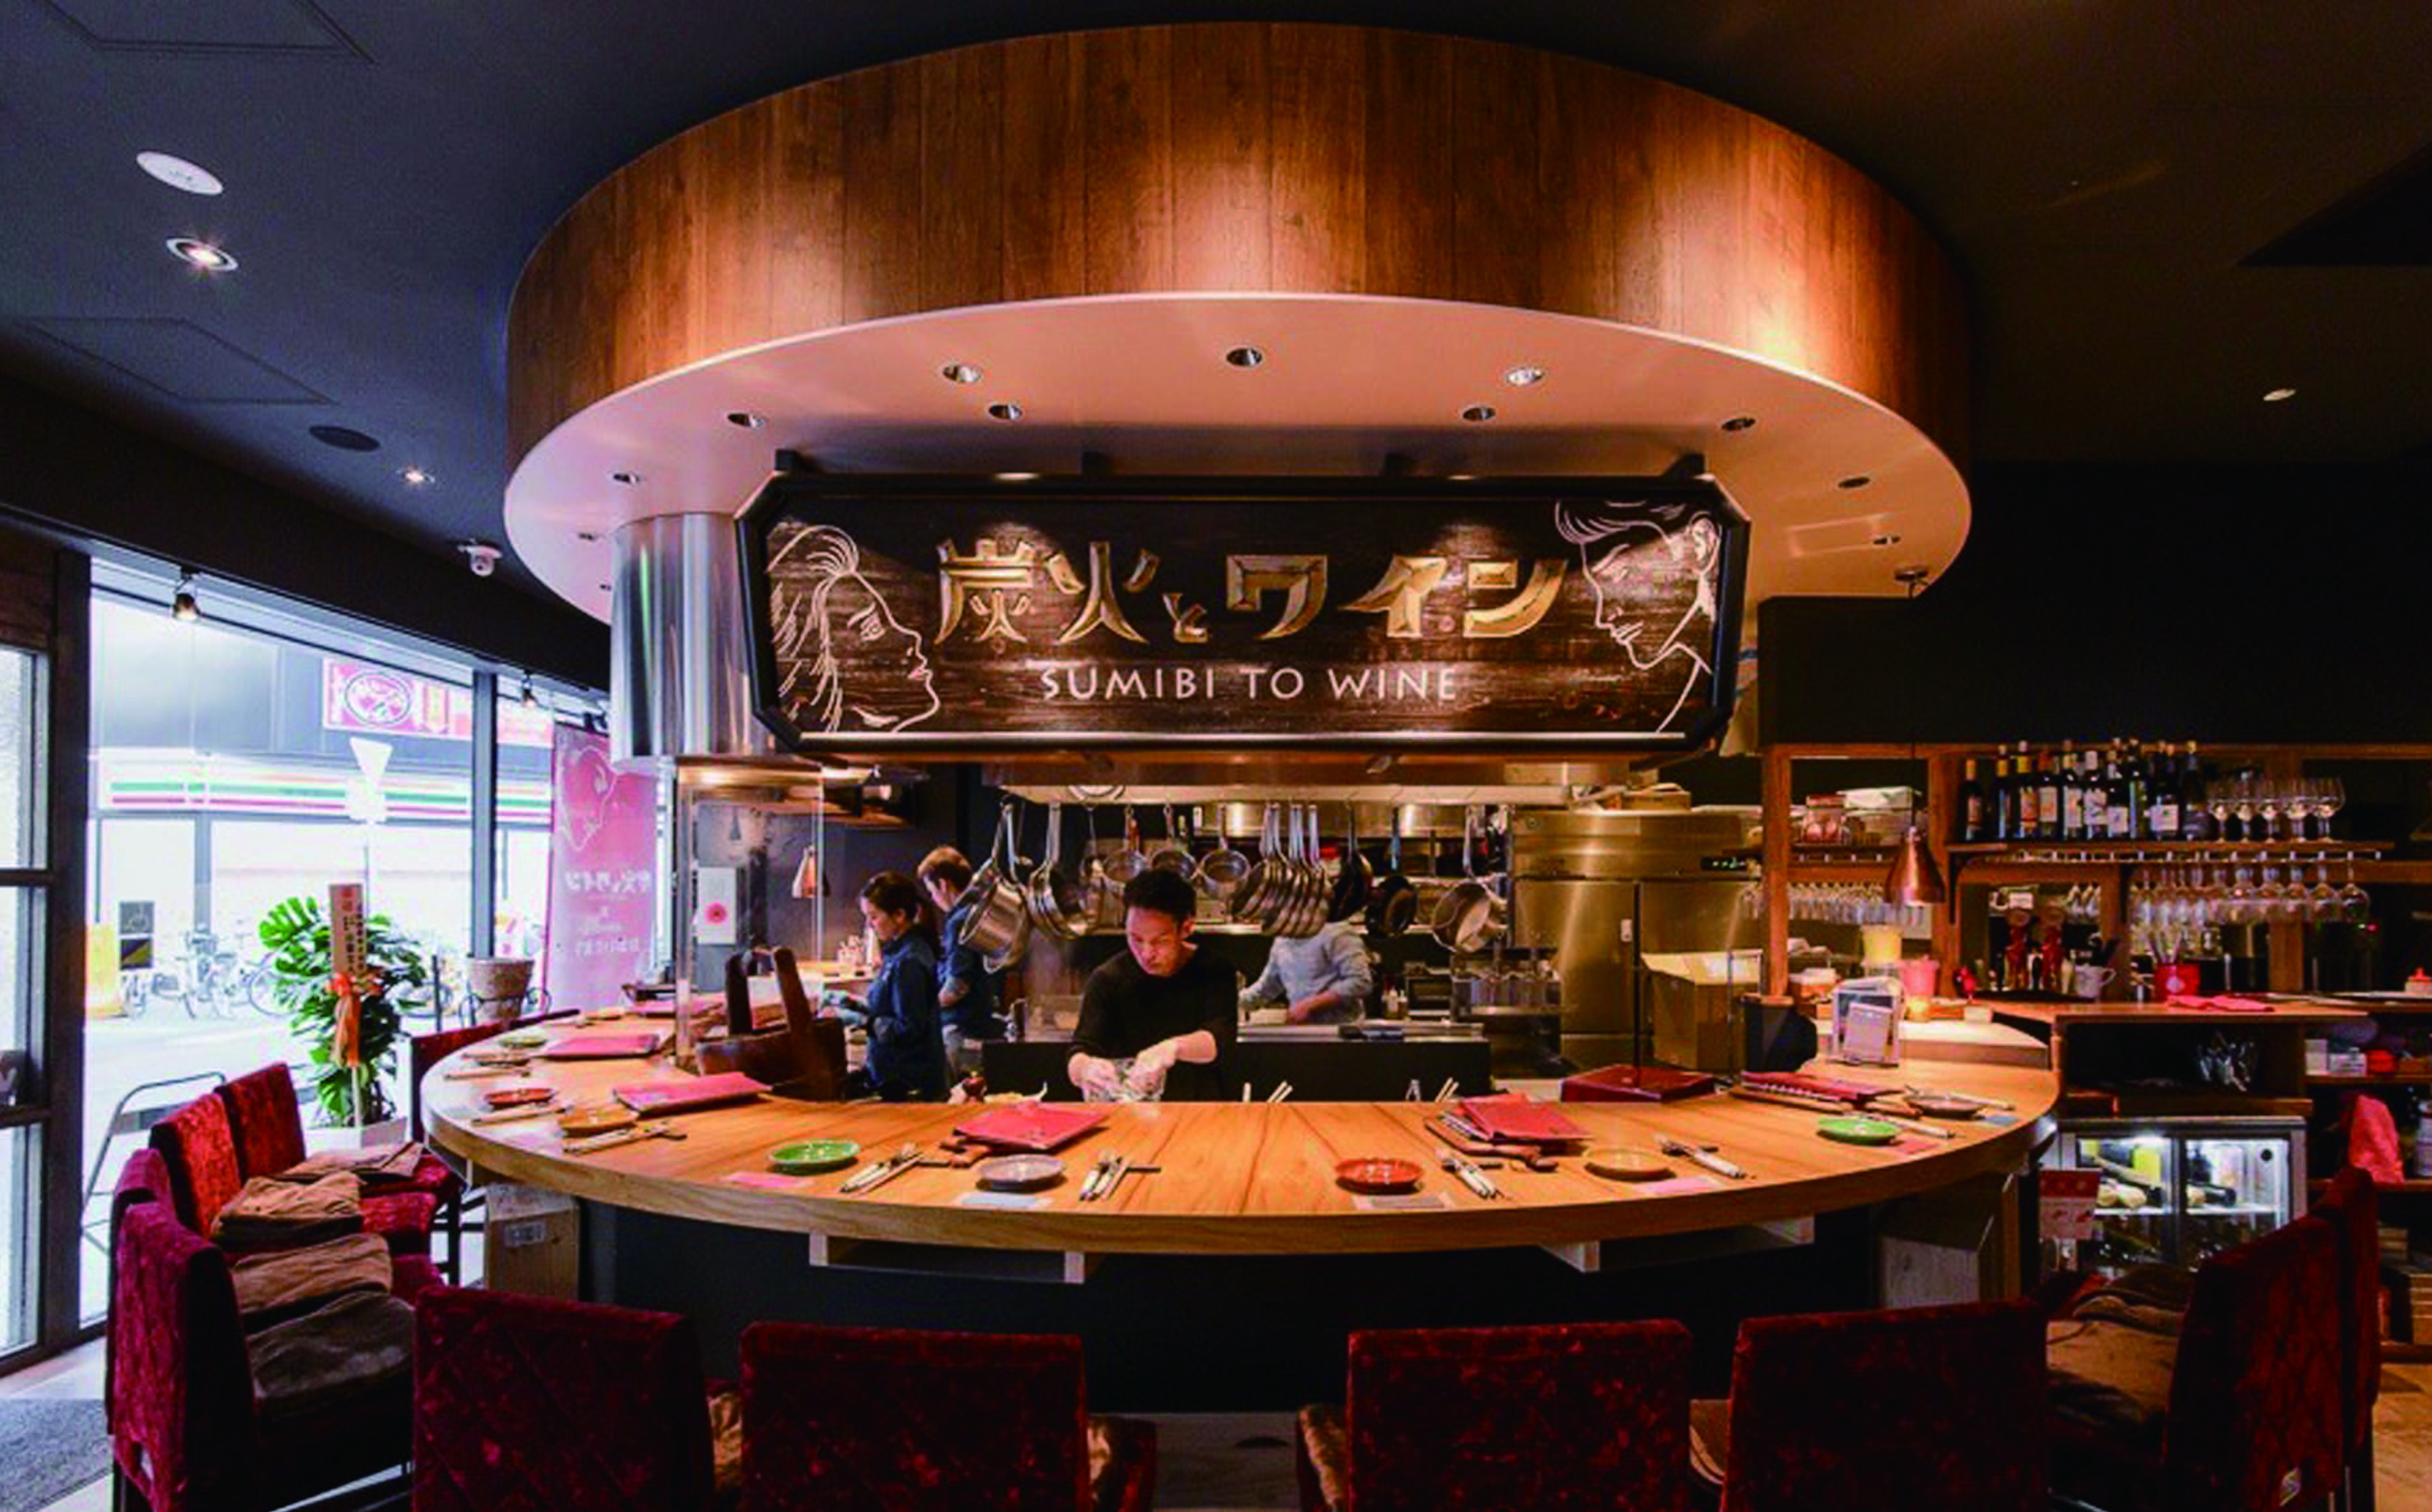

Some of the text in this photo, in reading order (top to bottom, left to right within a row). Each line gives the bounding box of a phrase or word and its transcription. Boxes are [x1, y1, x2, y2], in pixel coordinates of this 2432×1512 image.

[934, 537, 1568, 645] 炭火とワイン
[1040, 667, 1457, 701] SUMIBI TO WINE
